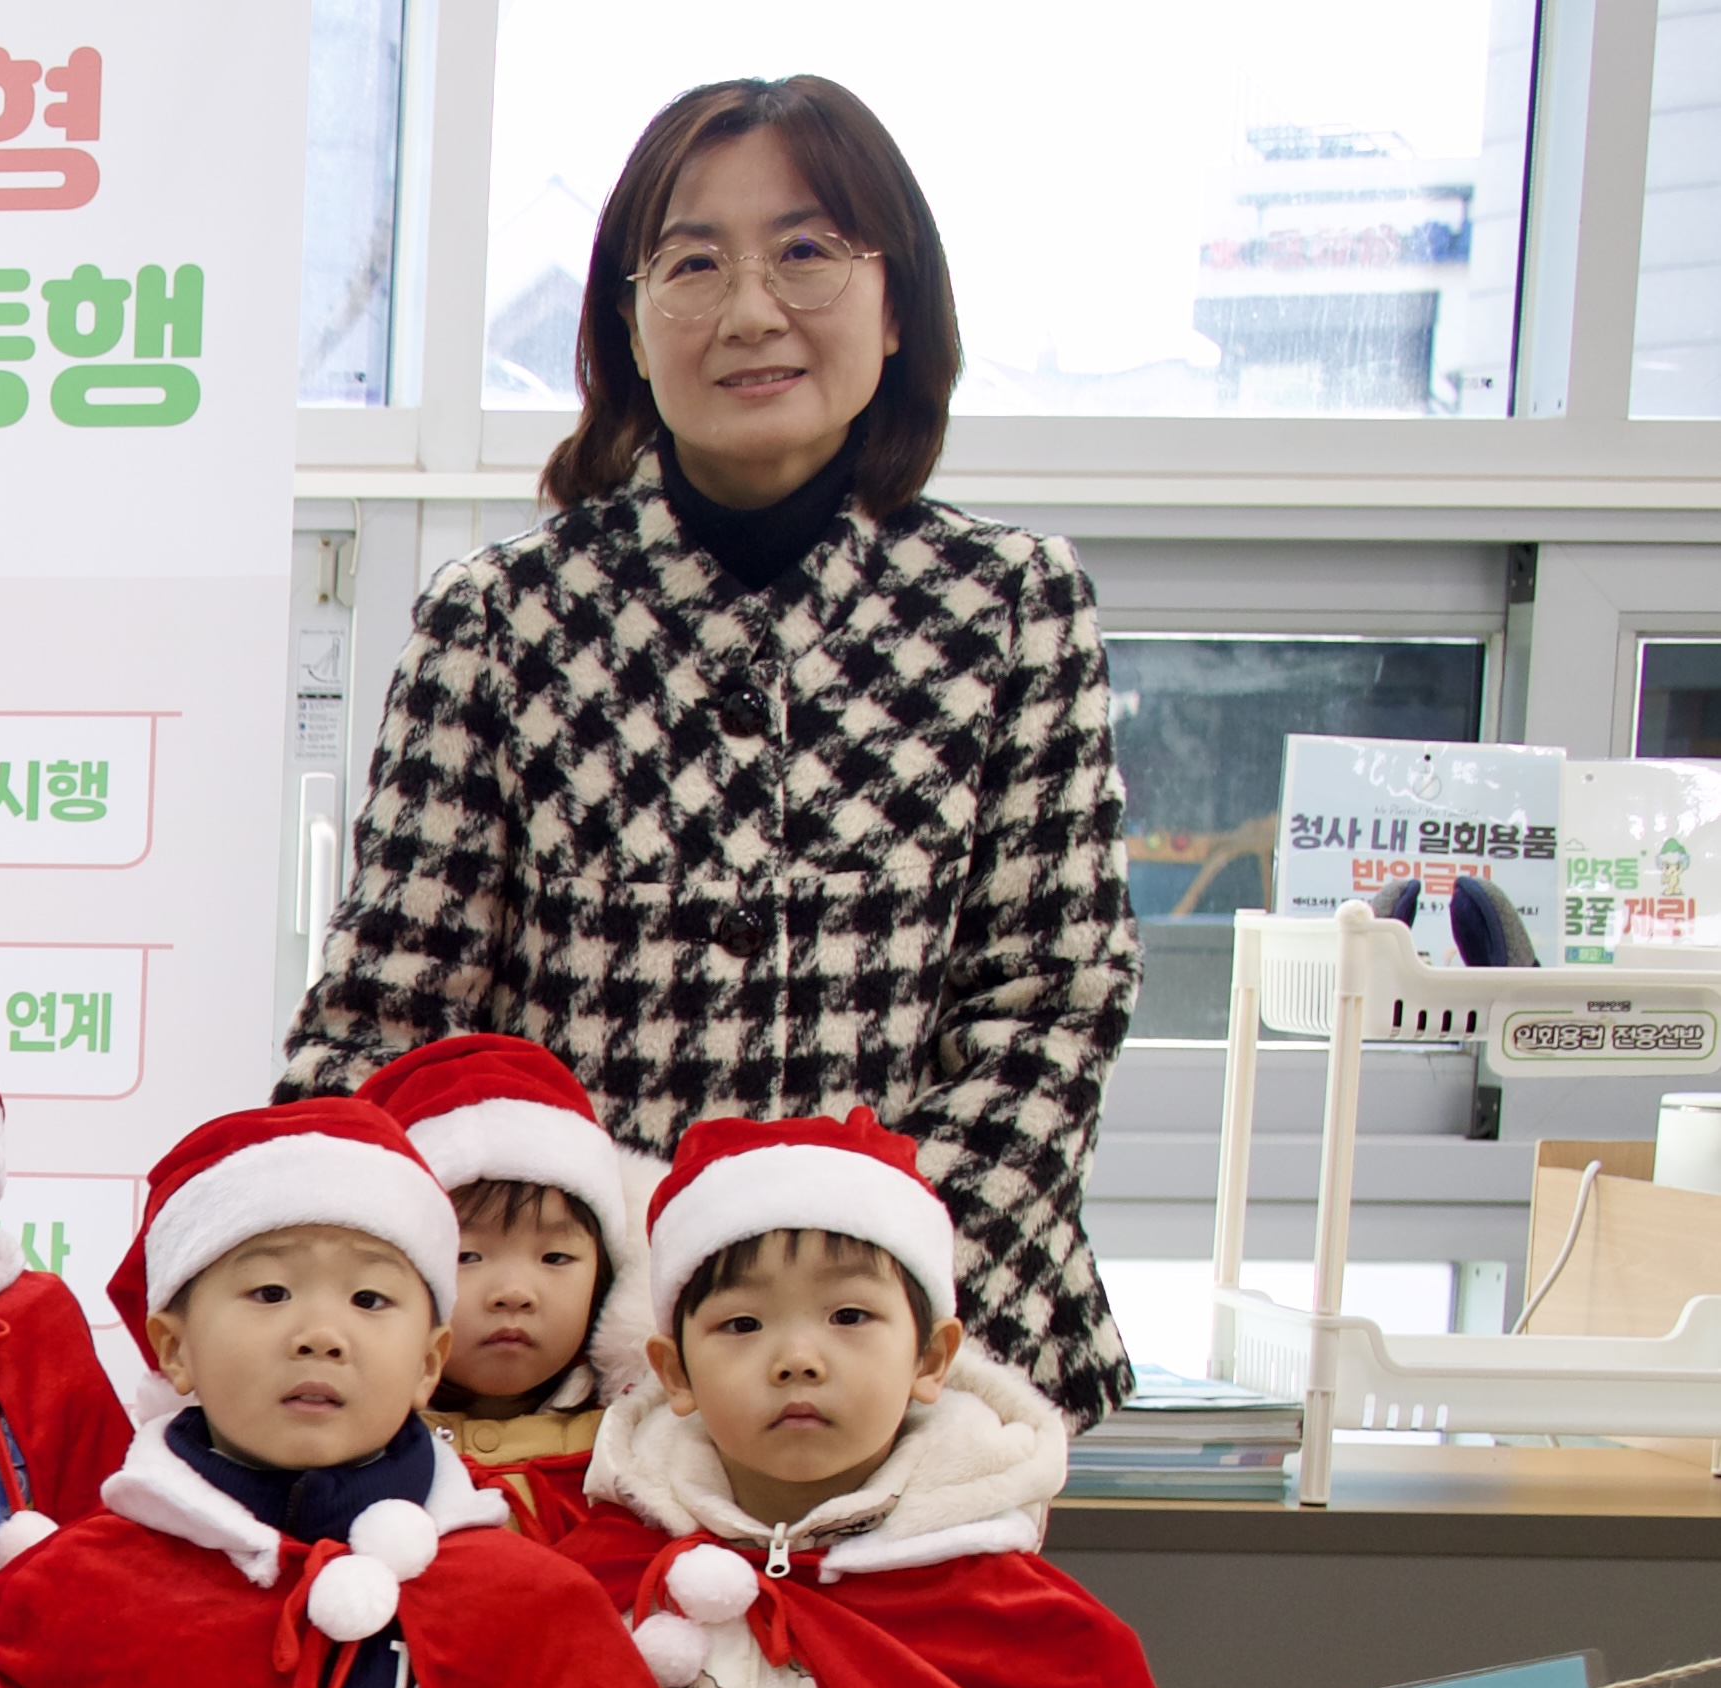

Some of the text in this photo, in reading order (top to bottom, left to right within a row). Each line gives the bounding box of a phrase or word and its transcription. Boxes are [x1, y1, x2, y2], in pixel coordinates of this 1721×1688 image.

[1291, 813, 1558, 860] 청사 내 일회용품
[6, 992, 113, 1054] 연계
[1514, 1024, 1704, 1050] 일회용컵 전용선반
